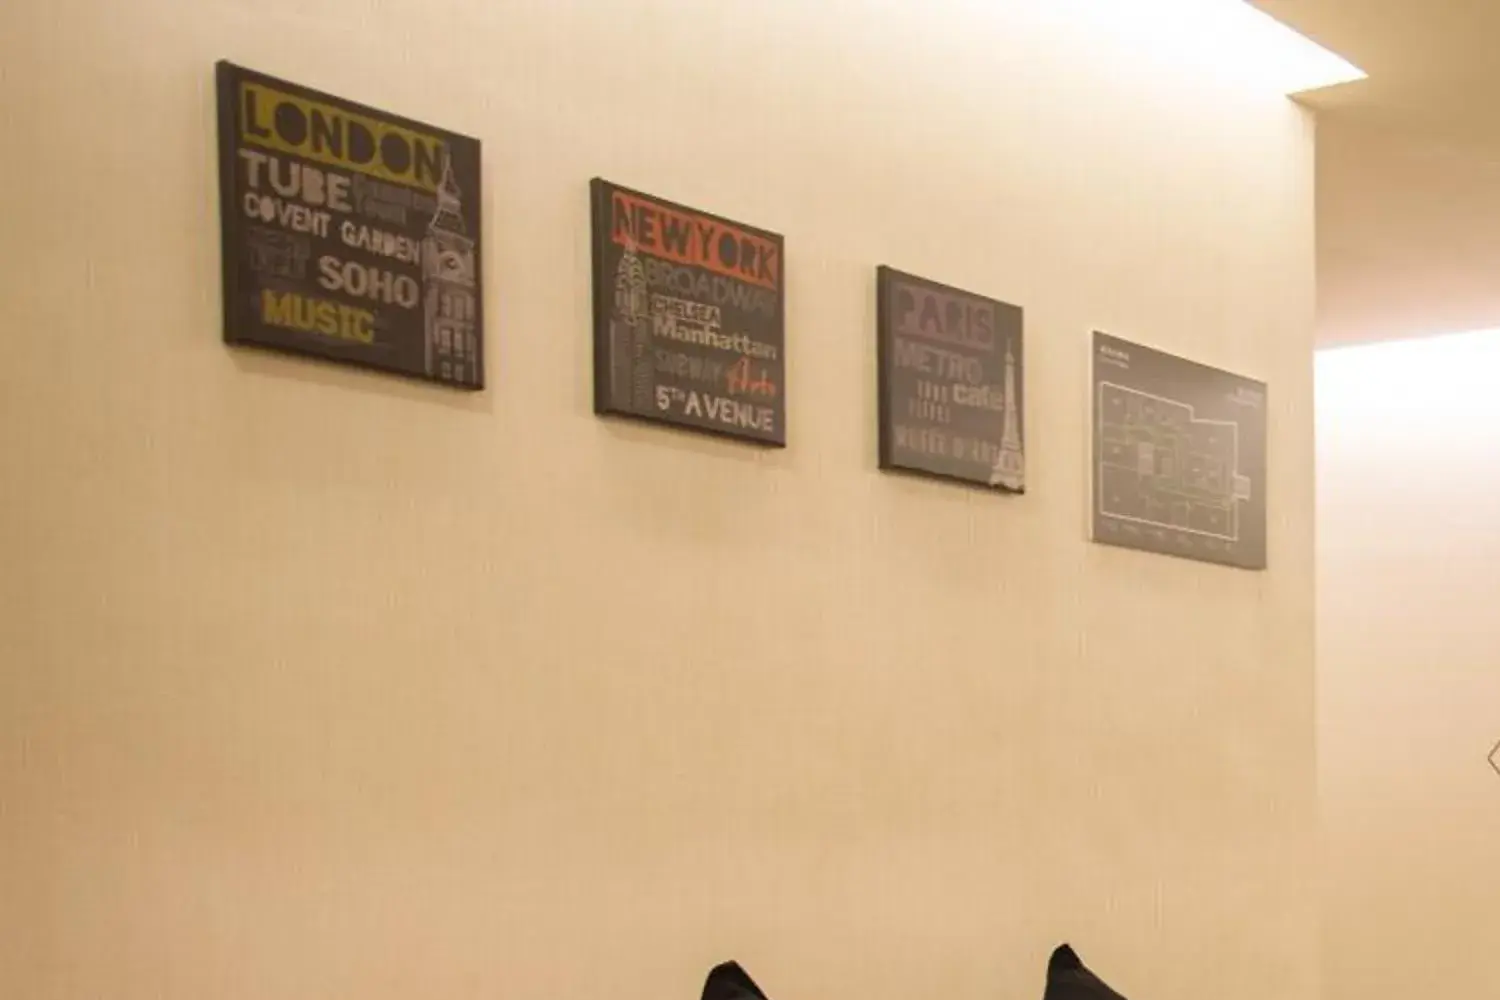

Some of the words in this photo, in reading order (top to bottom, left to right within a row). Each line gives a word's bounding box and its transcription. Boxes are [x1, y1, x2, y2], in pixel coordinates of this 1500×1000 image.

[244, 88, 442, 190] LONDON
[238, 148, 353, 213] TUBE
[242, 193, 332, 239] COVENT
[341, 220, 422, 265] GARDEN
[317, 254, 419, 309] SOHO
[260, 288, 376, 345] MUSIC
[653, 316, 778, 360] Manhattan
[683, 392, 775, 432] AVENUE
